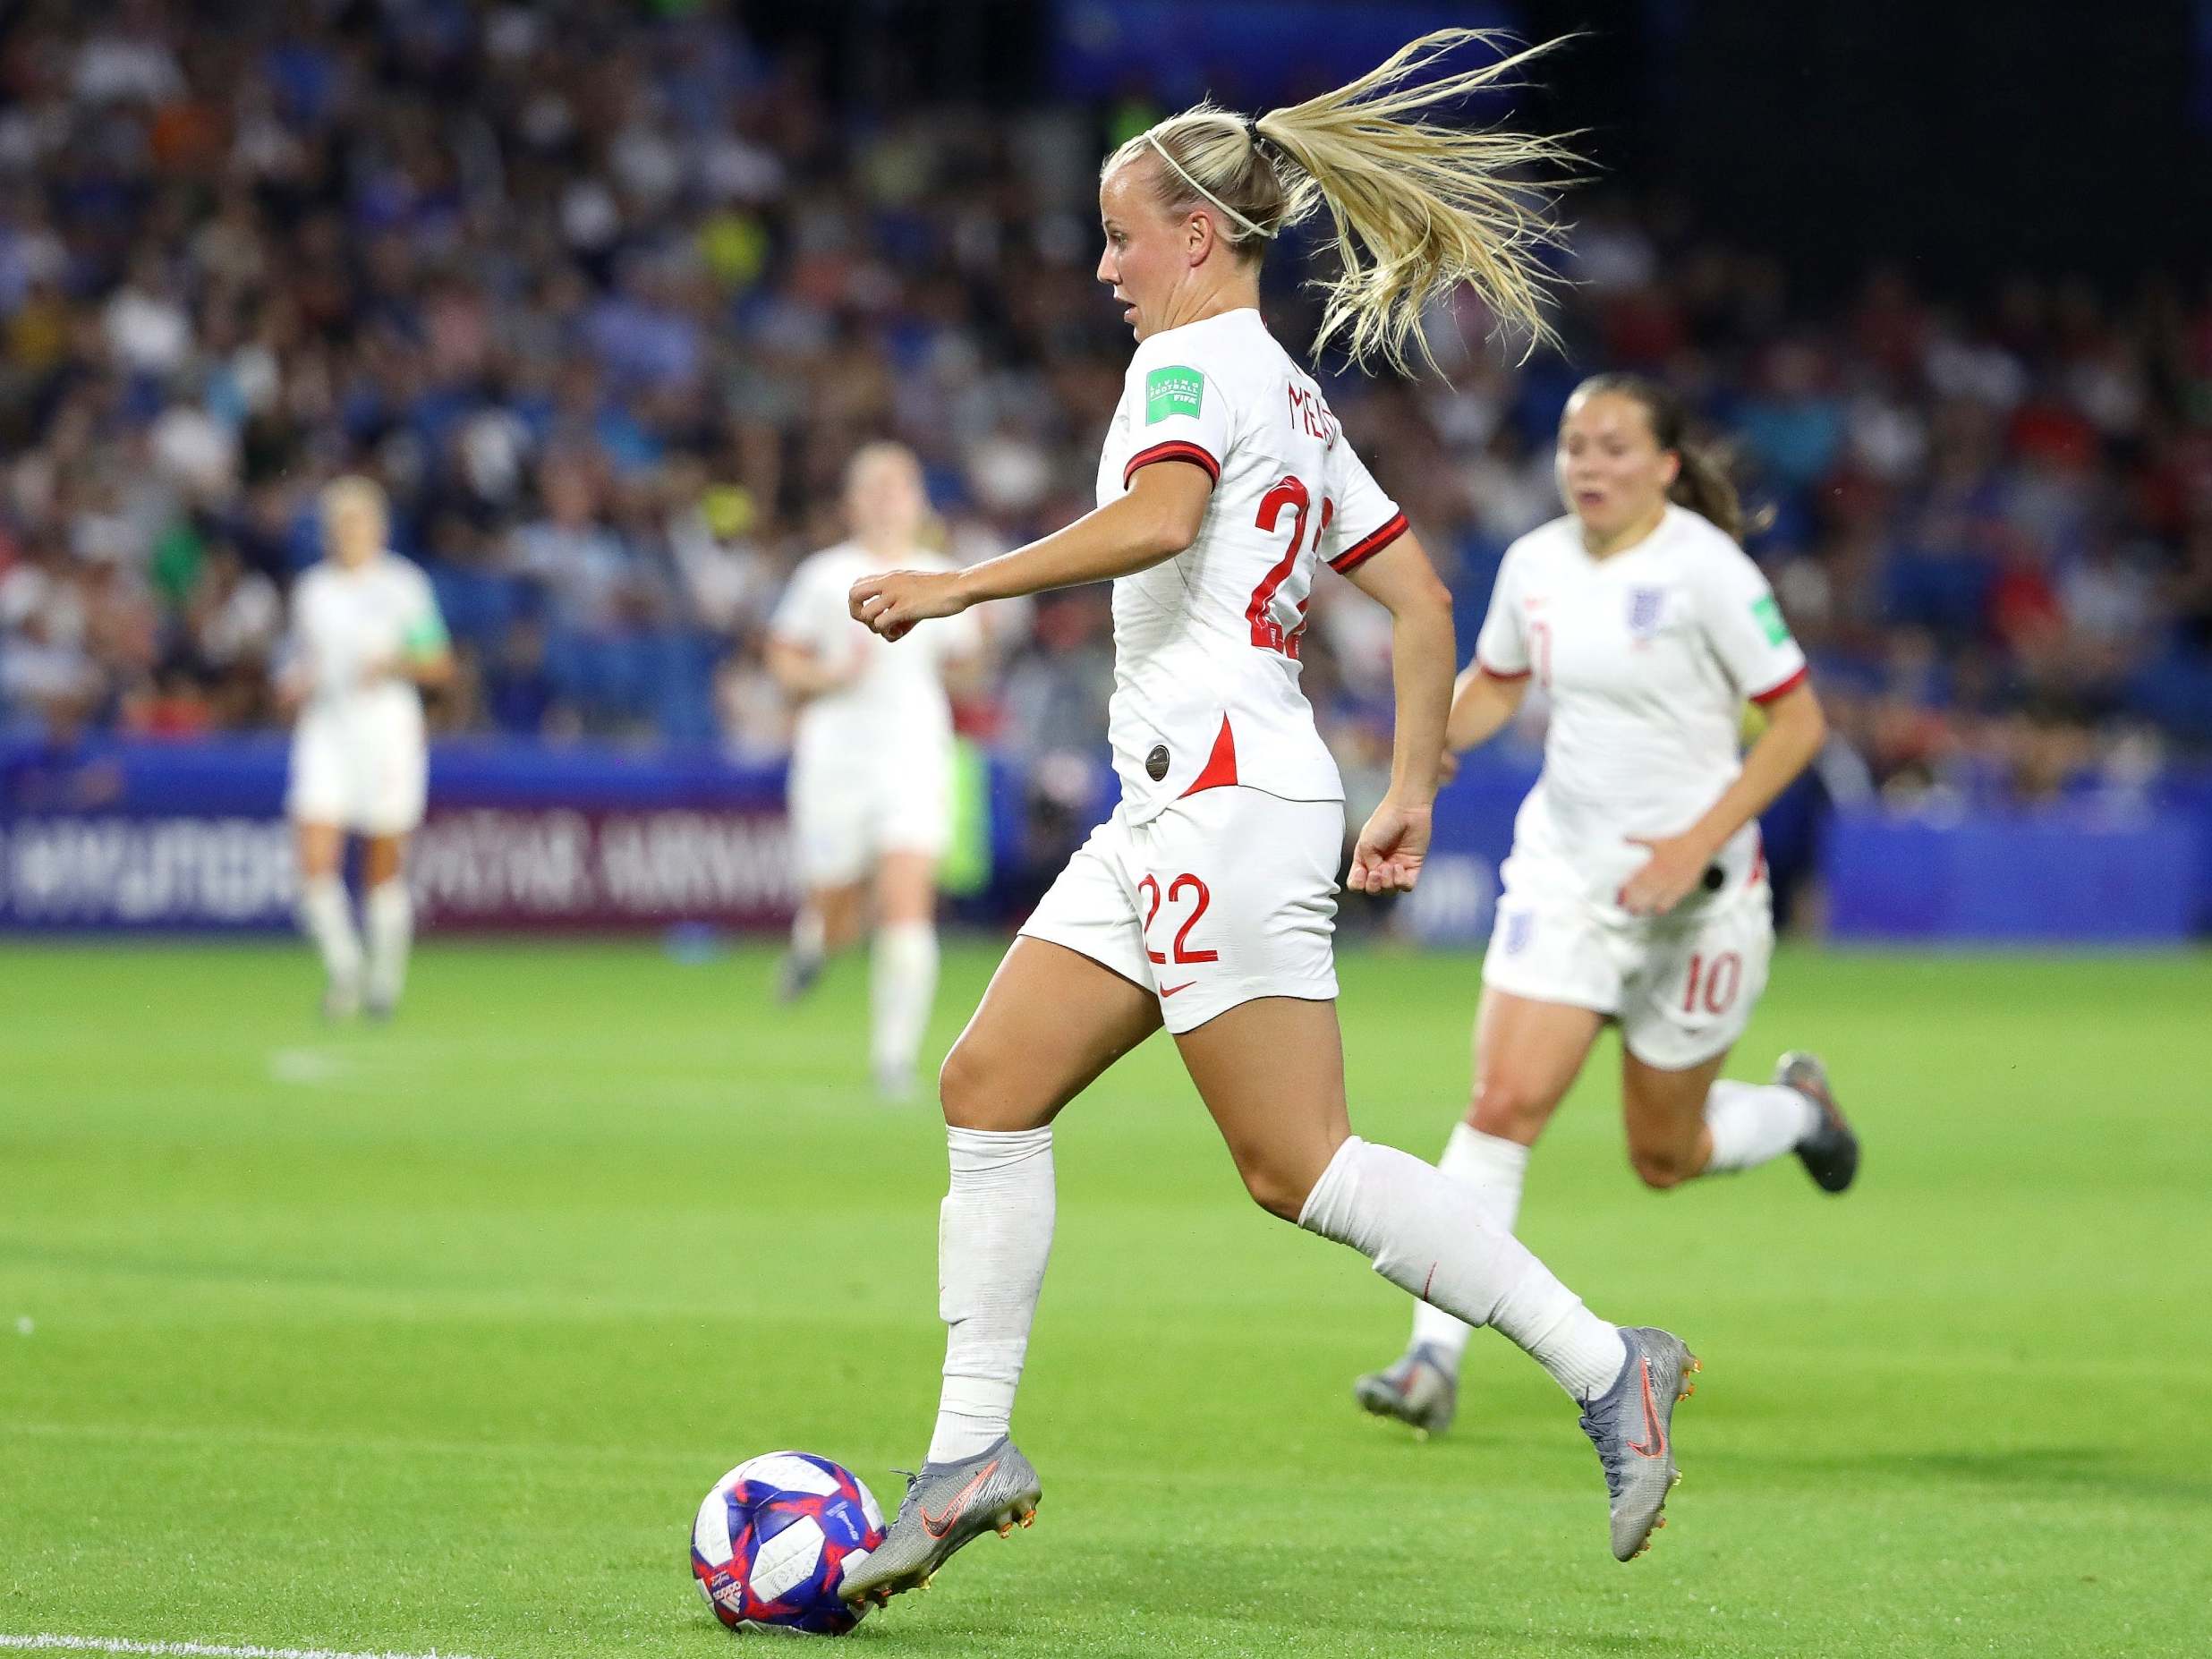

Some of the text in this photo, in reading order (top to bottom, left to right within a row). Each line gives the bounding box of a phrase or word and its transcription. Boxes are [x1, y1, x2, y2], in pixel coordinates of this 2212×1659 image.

[1150, 379, 1199, 392] LIVING
[1150, 385, 1198, 399] FOOTBALL
[1138, 872, 1220, 965] 22
[1684, 951, 1742, 1014] 10
